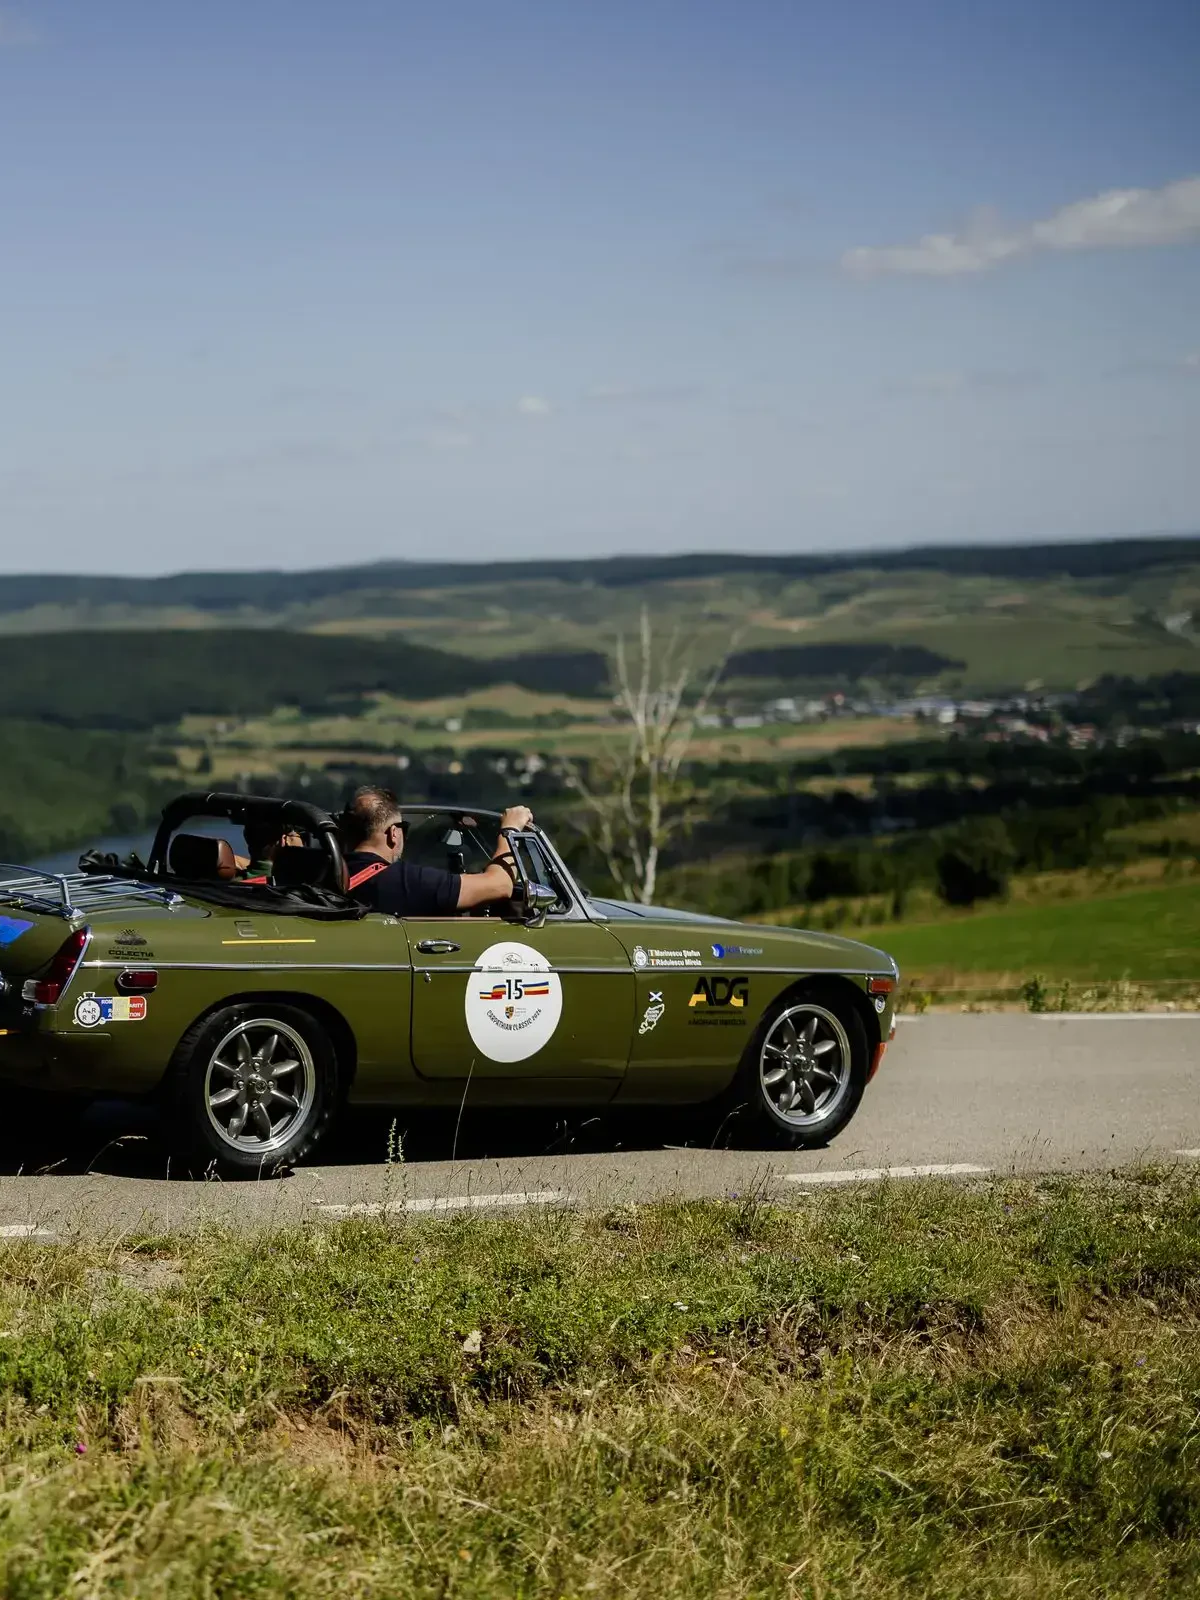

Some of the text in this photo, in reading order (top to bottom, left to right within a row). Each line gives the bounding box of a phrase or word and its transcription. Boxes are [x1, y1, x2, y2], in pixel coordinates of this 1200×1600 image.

[506, 979, 523, 1000] 15
[688, 977, 748, 1007] ADG
[486, 1009, 513, 1031] CARPATHIAN
[512, 1017, 532, 1031] CLASSIC
